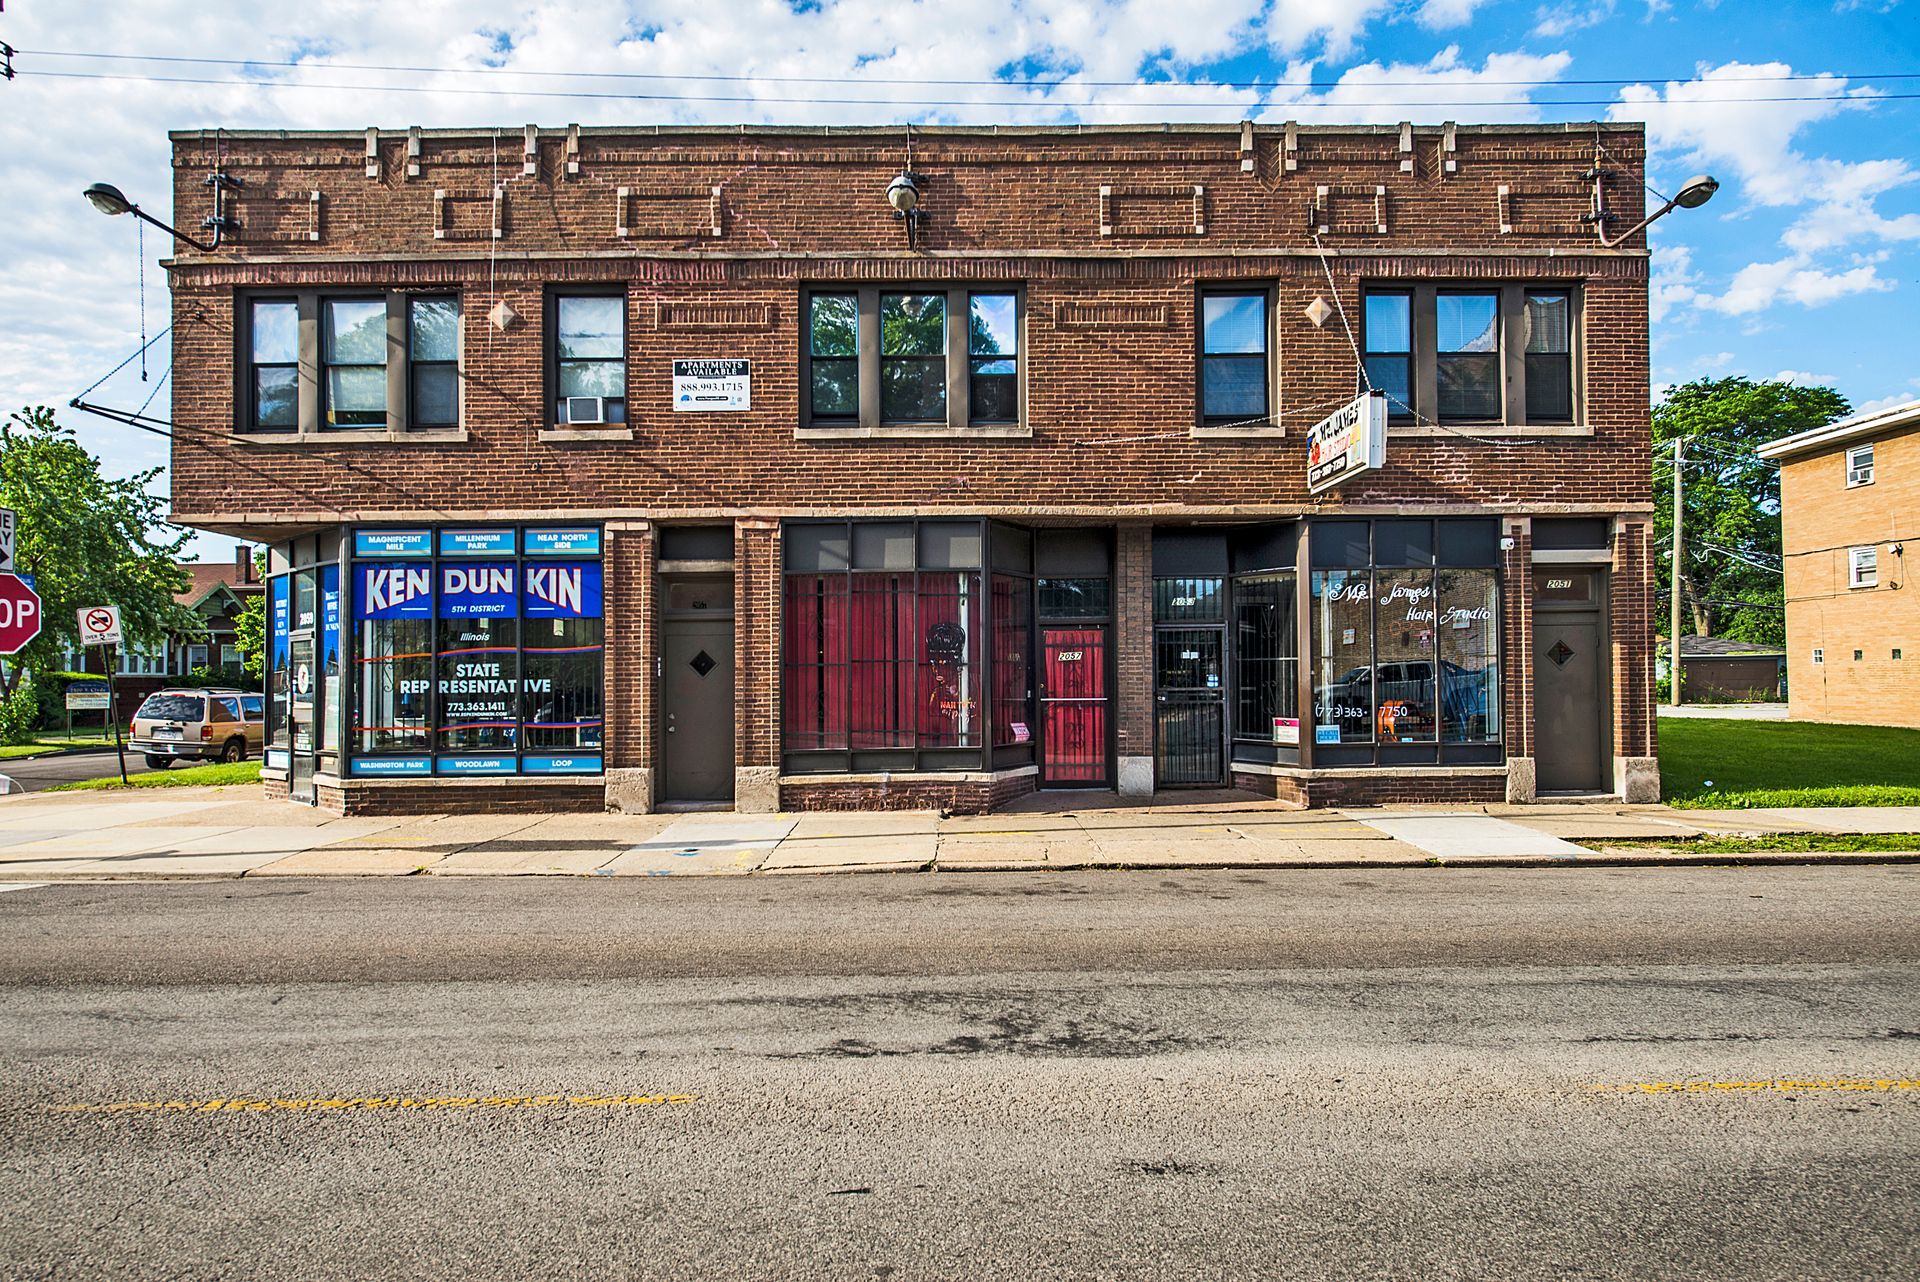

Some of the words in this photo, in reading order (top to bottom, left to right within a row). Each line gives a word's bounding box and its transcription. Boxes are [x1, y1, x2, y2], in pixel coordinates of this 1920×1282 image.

[681, 361, 743, 369] APARTMENTS
[680, 383, 743, 391] 888.993.1715
[0, 514, 11, 529] E
[0, 531, 12, 546] Y
[1547, 580, 1571, 588] 2051
[365, 568, 430, 615] KEN
[1381, 583, 1430, 605] James
[469, 604, 505, 612] DISTRICT
[460, 632, 490, 642] Illinois
[1059, 652, 1082, 660] 2057
[456, 663, 500, 677] STATE
[447, 702, 505, 712] 773.363.1411
